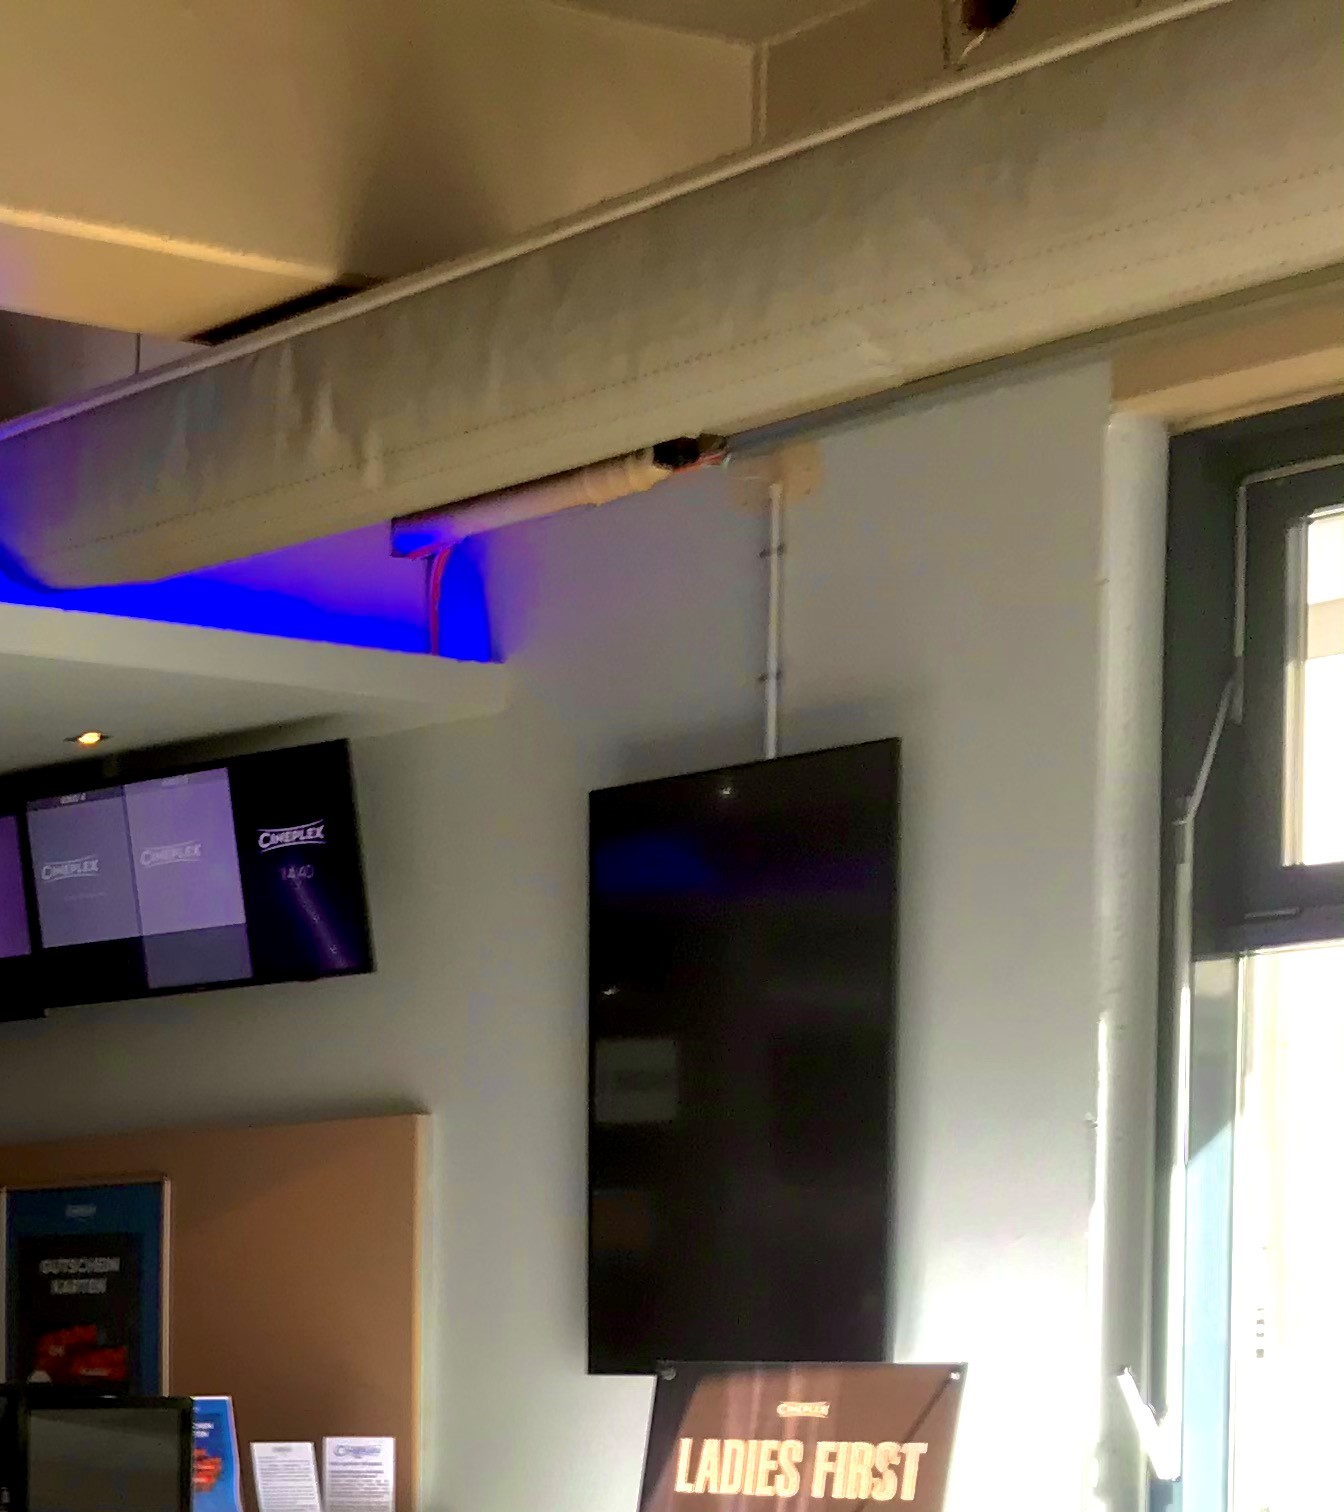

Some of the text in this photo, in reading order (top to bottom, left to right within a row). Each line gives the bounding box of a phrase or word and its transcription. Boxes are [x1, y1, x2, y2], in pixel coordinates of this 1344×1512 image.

[258, 825, 326, 849] CINEPLEX
[675, 1437, 929, 1501] LADIES FIRST
